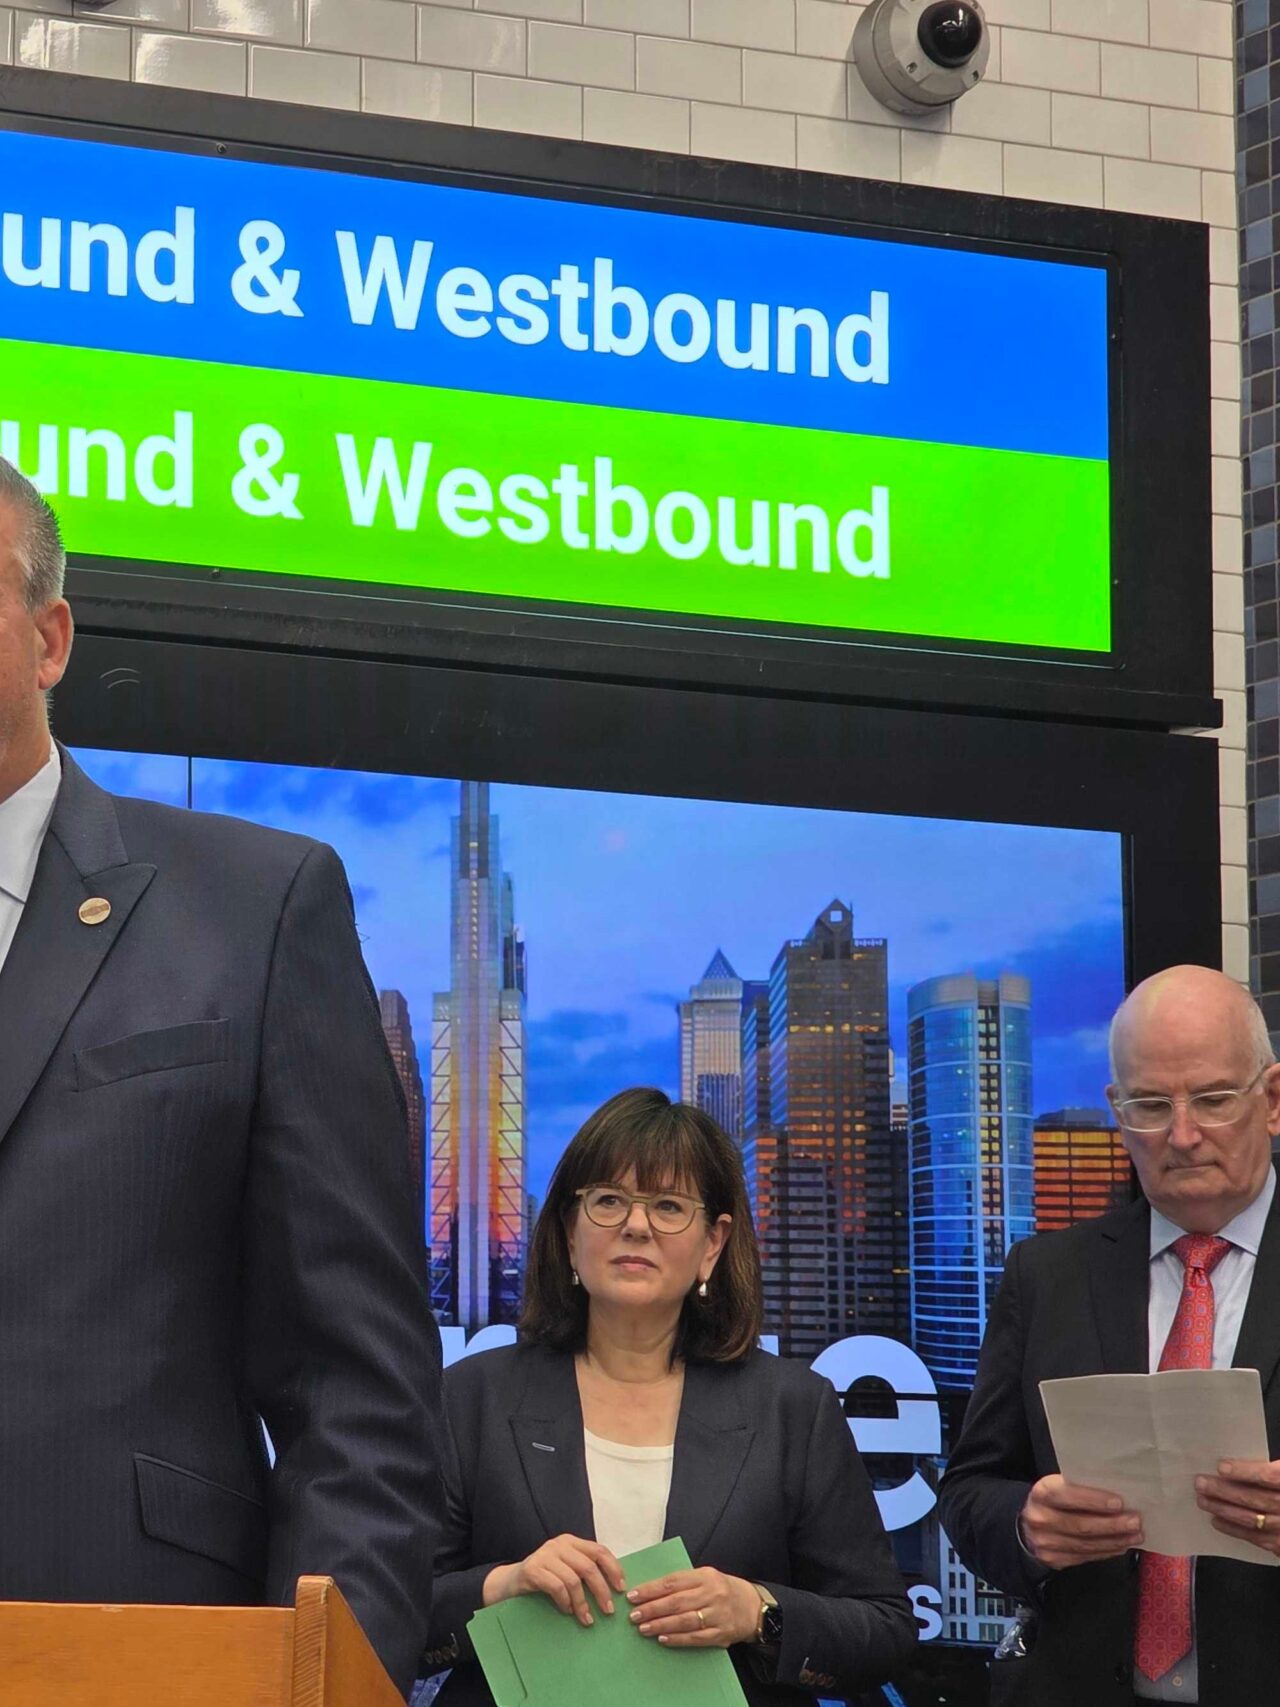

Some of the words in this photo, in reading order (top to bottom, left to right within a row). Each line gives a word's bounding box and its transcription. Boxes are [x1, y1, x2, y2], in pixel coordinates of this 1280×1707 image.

[231, 220, 303, 317] &
[335, 231, 889, 384] Westbound
[231, 423, 303, 520] &
[335, 433, 890, 579] Westbound
